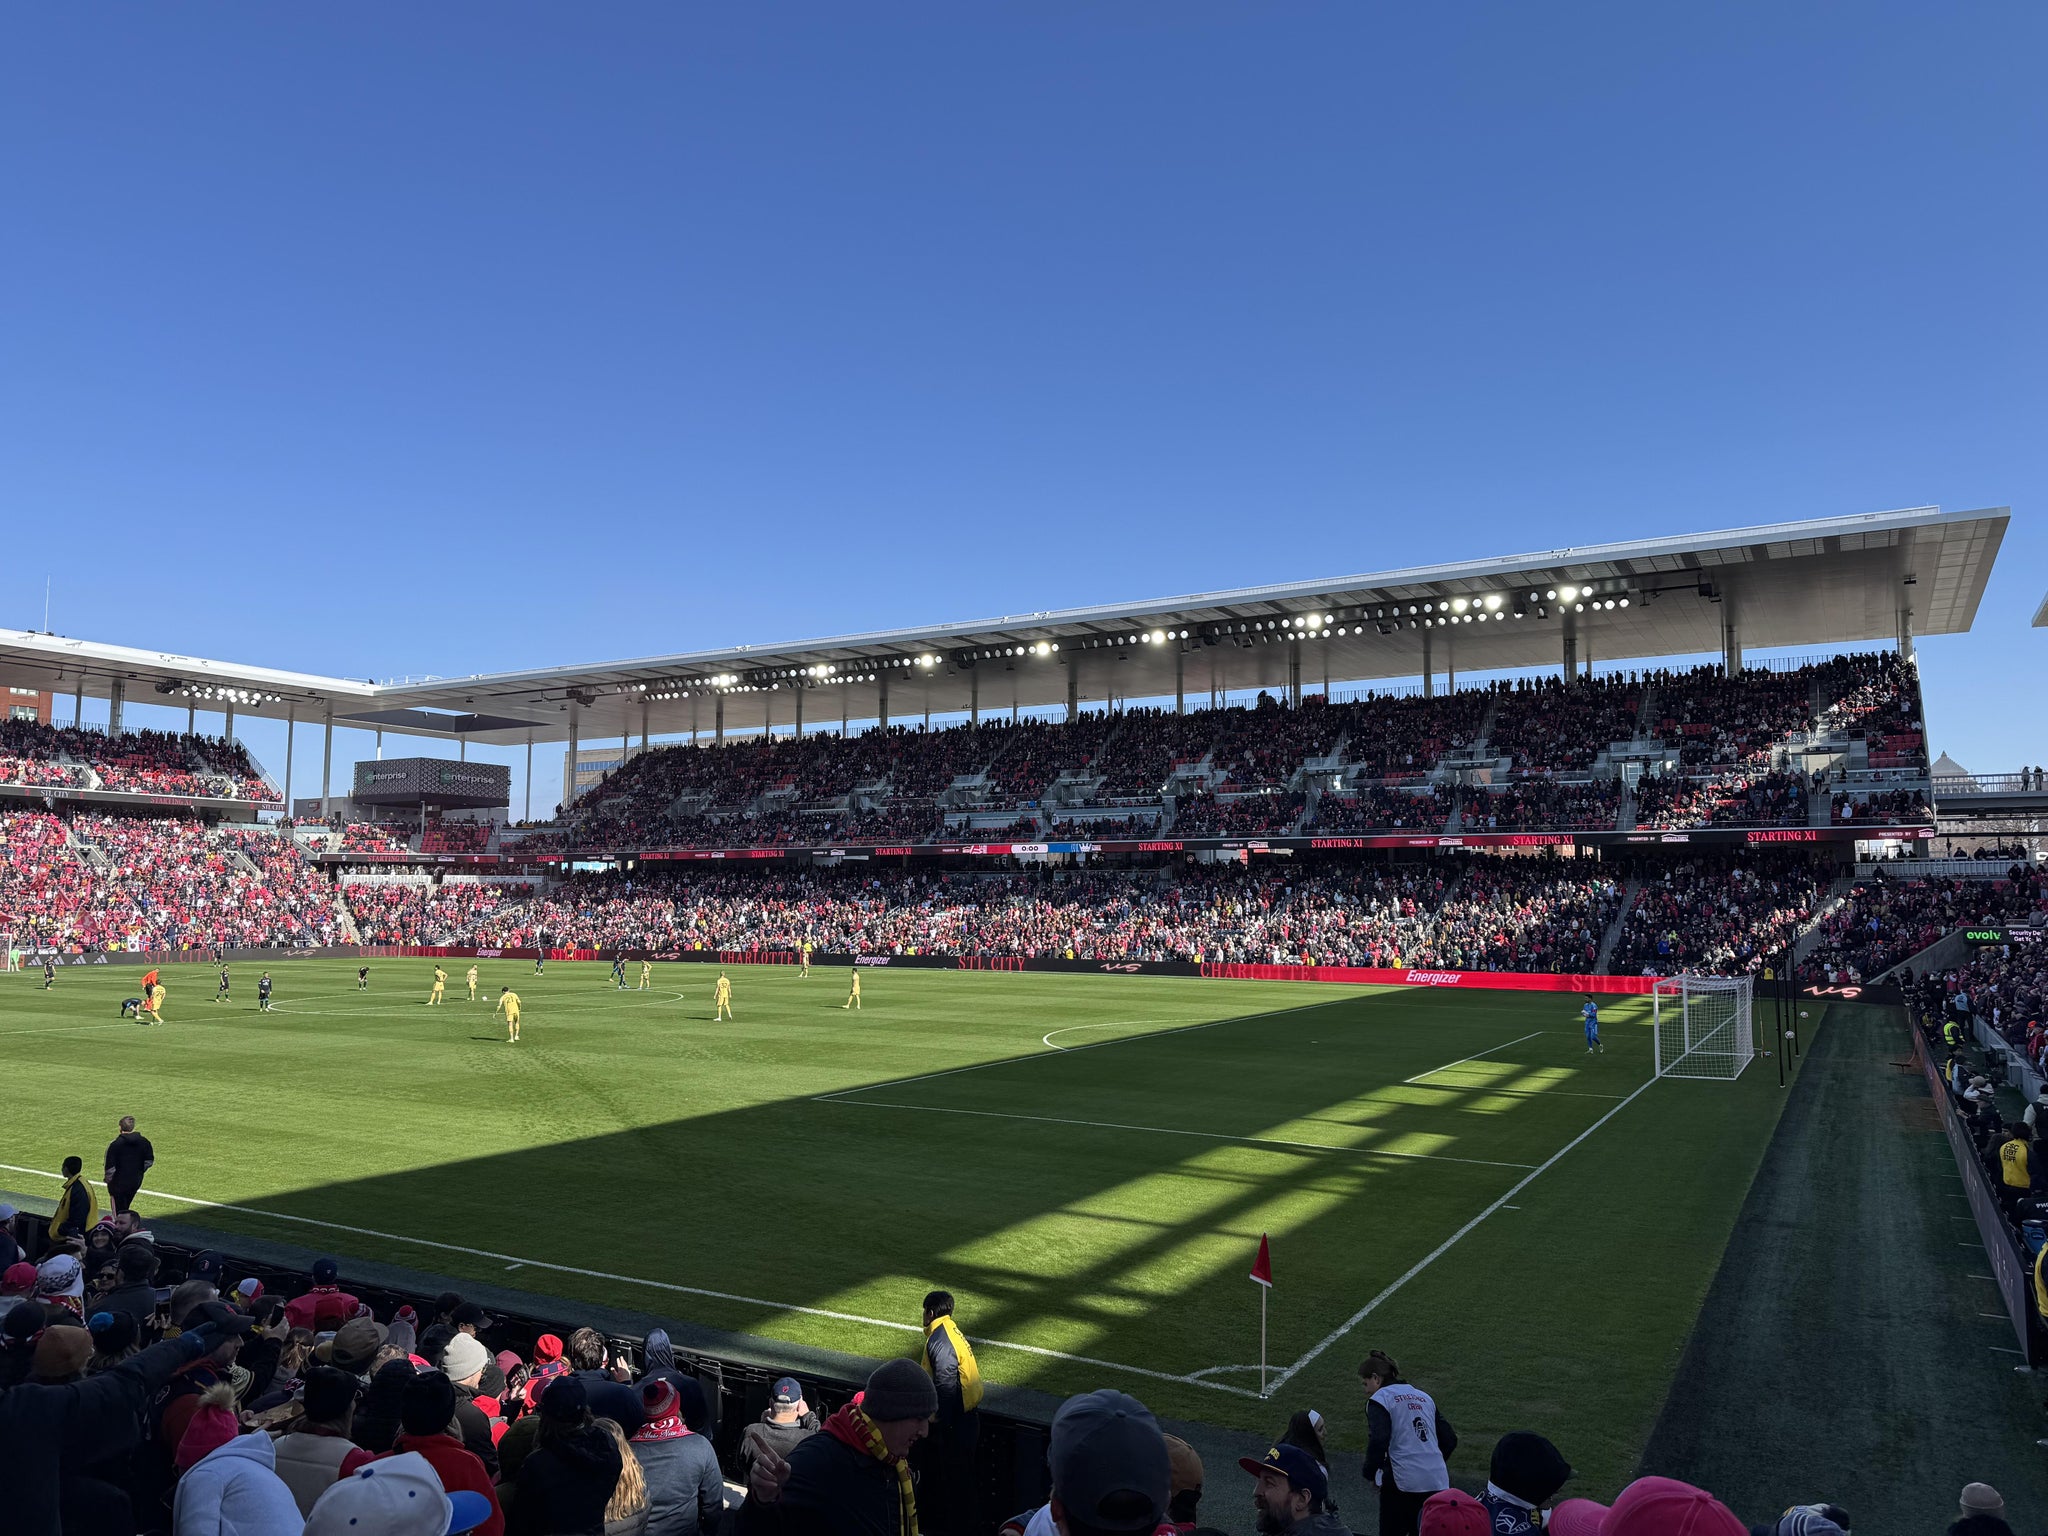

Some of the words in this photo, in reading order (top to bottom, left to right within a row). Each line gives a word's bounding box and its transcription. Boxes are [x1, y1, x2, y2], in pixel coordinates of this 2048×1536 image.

[366, 772, 407, 783] enterprise
[442, 772, 495, 785] enterprise
[40, 789, 53, 797] STL
[53, 790, 69, 798] CITY
[1513, 835, 1560, 845] STARTING
[1562, 835, 1573, 844] XI
[1747, 830, 1802, 841] STARTING
[1804, 830, 1816, 840] XI
[1138, 842, 1173, 850] STARTING
[1174, 842, 1183, 850] XI
[1311, 839, 1351, 848] STARTING
[1353, 838, 1363, 847] XI
[751, 850, 777, 858] STARTING
[1966, 929, 2001, 940] evolv
[143, 950, 173, 964] STL
[179, 950, 214, 963] CITY
[476, 947, 502, 957] Energizer
[719, 951, 794, 965] CHARLOTTE
[854, 953, 890, 966] Energizer
[958, 956, 985, 970] STL
[991, 956, 1026, 971] CITY
[1200, 961, 1311, 981] CHARLOTTE
[1405, 969, 1461, 985] Energizer
[1571, 974, 1614, 993] STL
